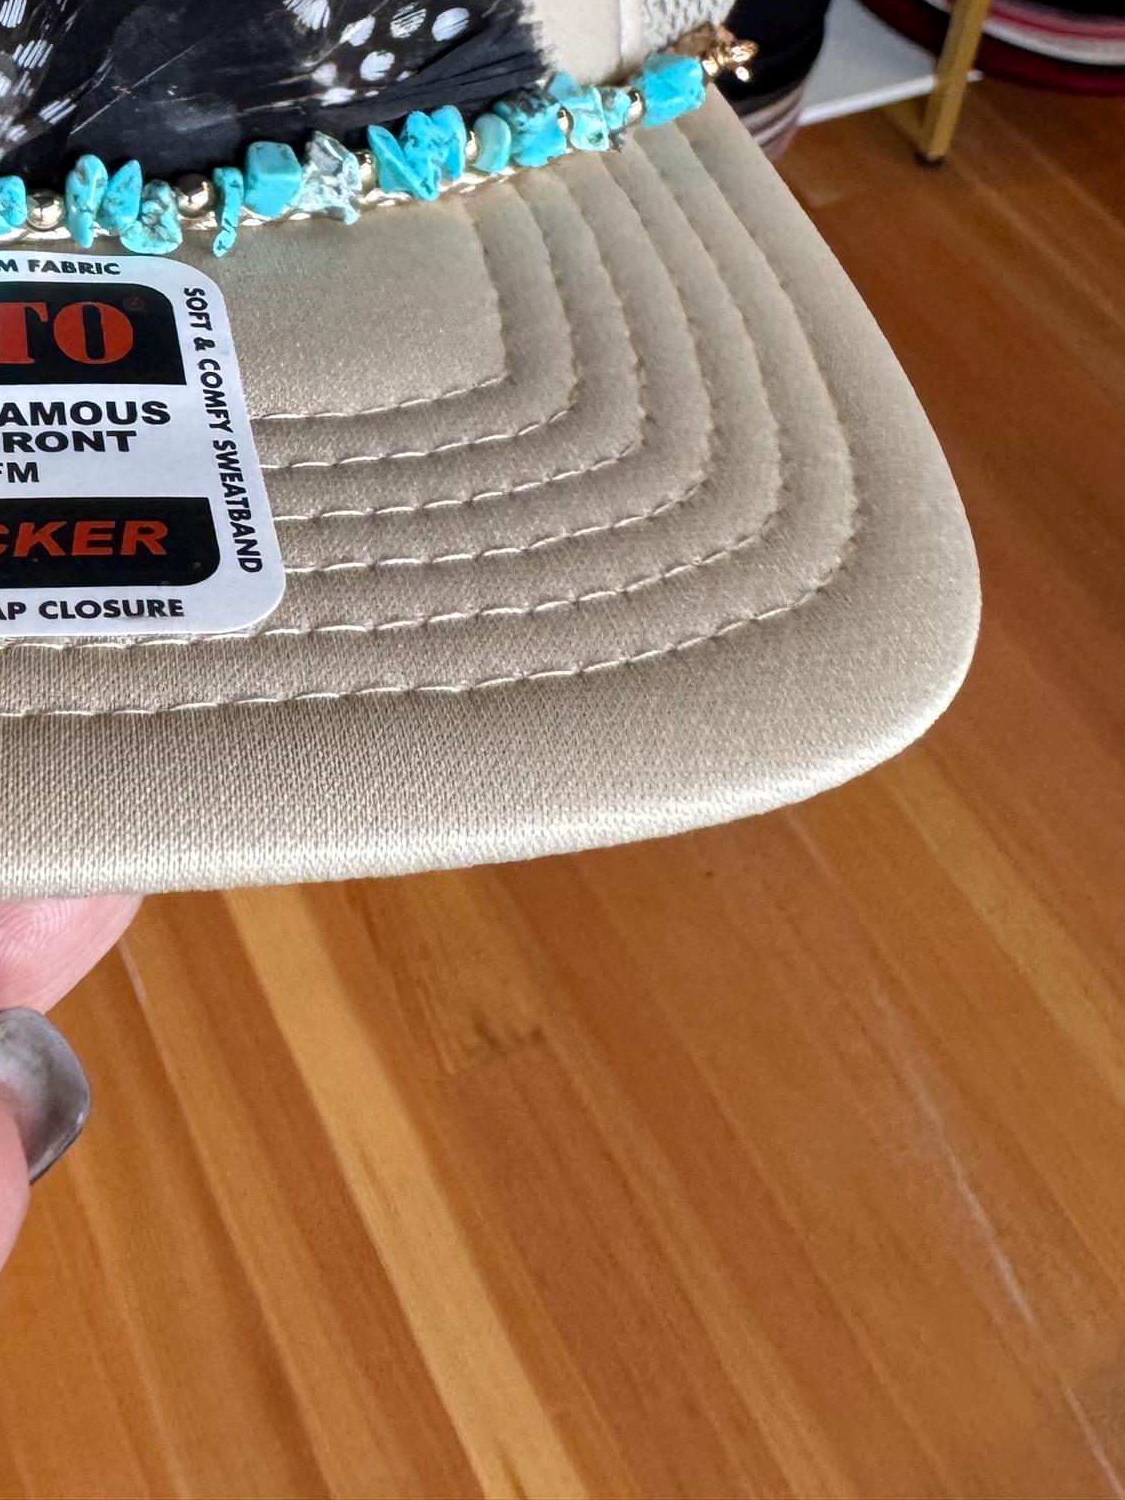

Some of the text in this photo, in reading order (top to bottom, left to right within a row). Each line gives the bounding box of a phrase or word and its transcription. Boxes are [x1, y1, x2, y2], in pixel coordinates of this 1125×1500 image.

[28, 259, 121, 276] FABRIC
[183, 287, 263, 575] SOFT & COMFY SWEATBAND
[38, 598, 185, 620] CLOSURE
